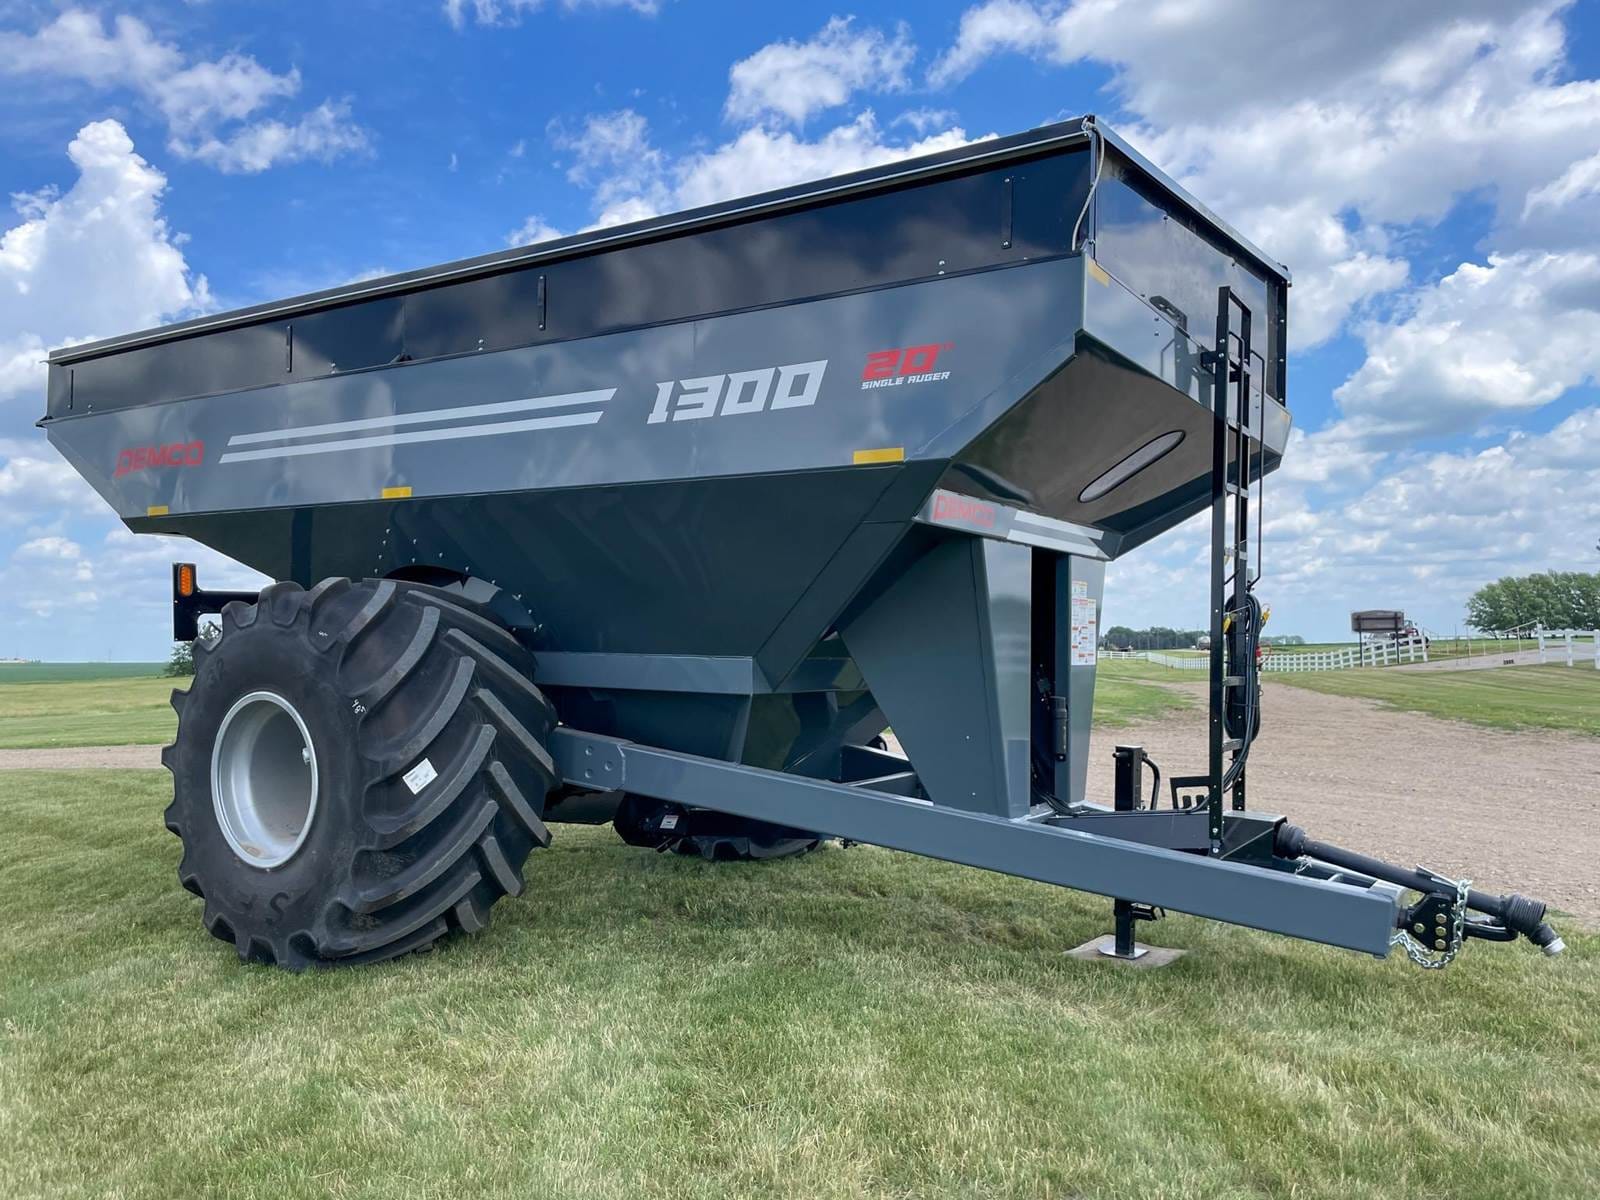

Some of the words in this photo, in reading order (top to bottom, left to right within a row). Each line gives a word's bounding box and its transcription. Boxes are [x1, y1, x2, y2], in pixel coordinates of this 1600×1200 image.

[647, 360, 828, 424] 1300
[861, 377, 905, 390] SINGLE
[907, 371, 951, 384] AUGER
[113, 439, 205, 479] DEMCO
